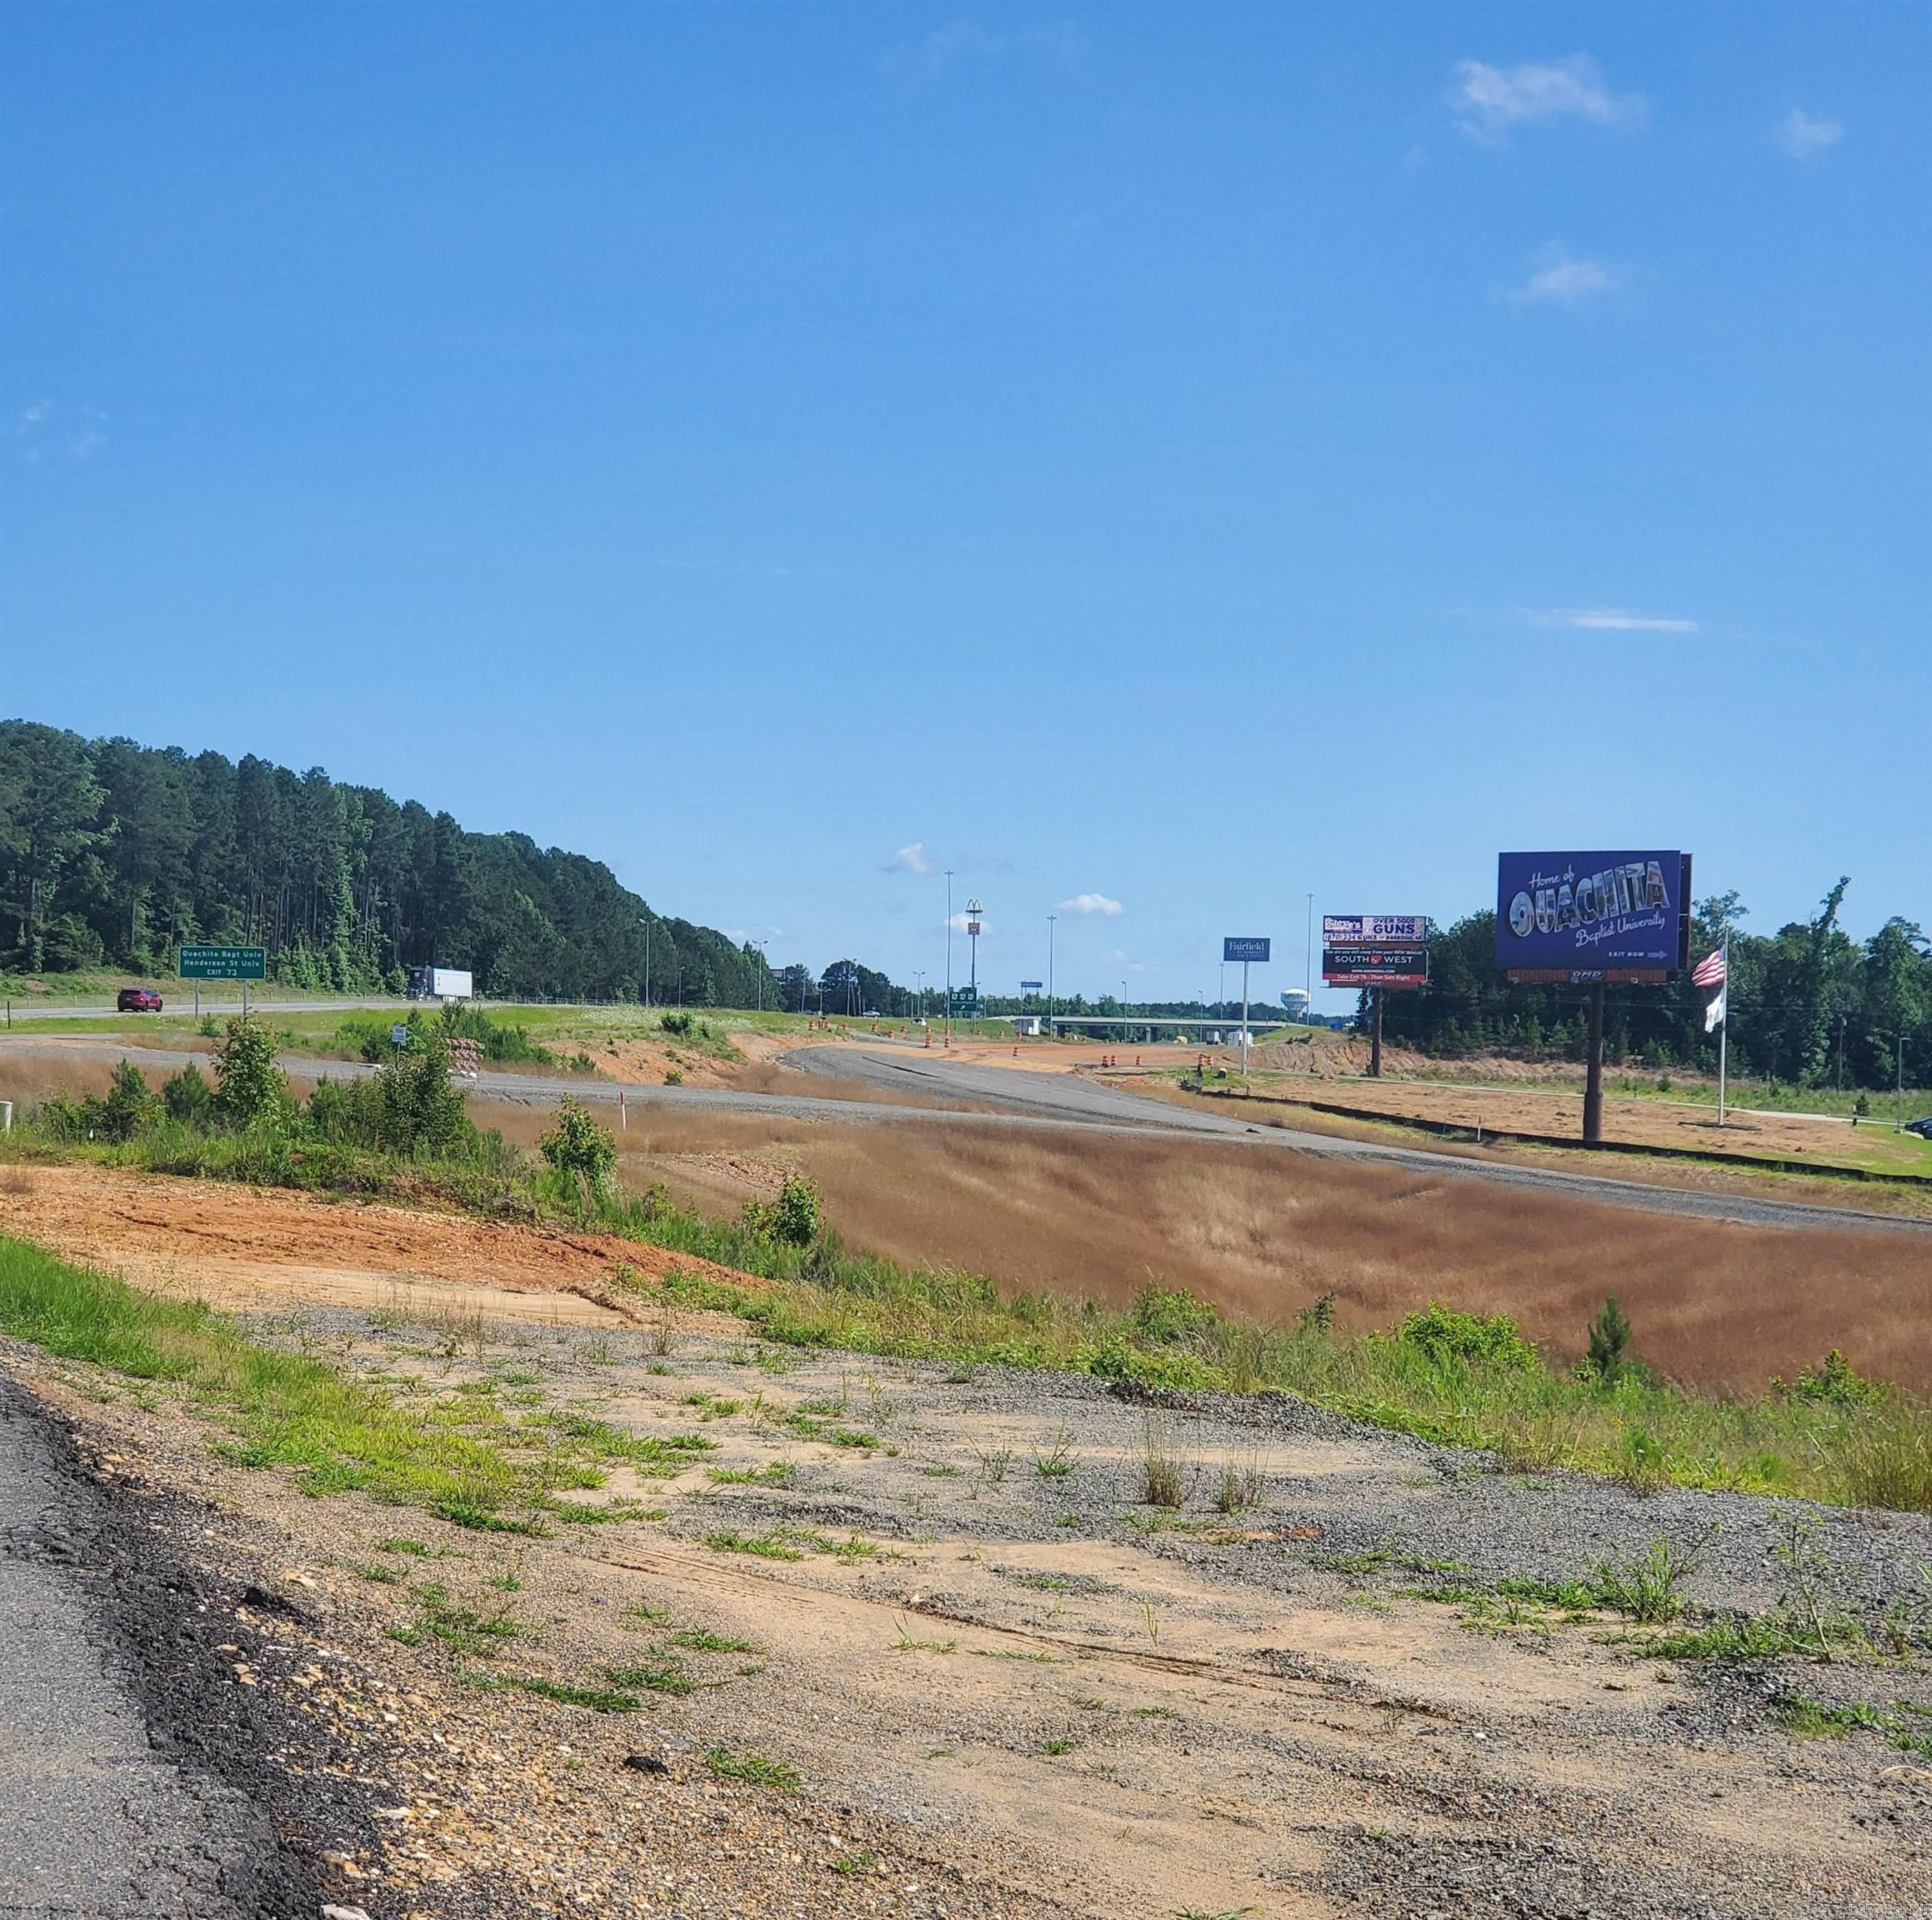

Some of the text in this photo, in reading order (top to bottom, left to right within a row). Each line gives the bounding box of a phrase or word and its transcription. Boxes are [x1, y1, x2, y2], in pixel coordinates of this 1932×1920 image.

[1528, 864, 1576, 889] Home of
[1509, 860, 1670, 938] OUACHITA
[1327, 918, 1361, 928] Steve's
[1373, 924, 1415, 934] GUNS
[1574, 909, 1666, 948] Baptist University
[1229, 941, 1264, 951] Fairfield
[1334, 955, 1414, 964] SOUTH WEST
